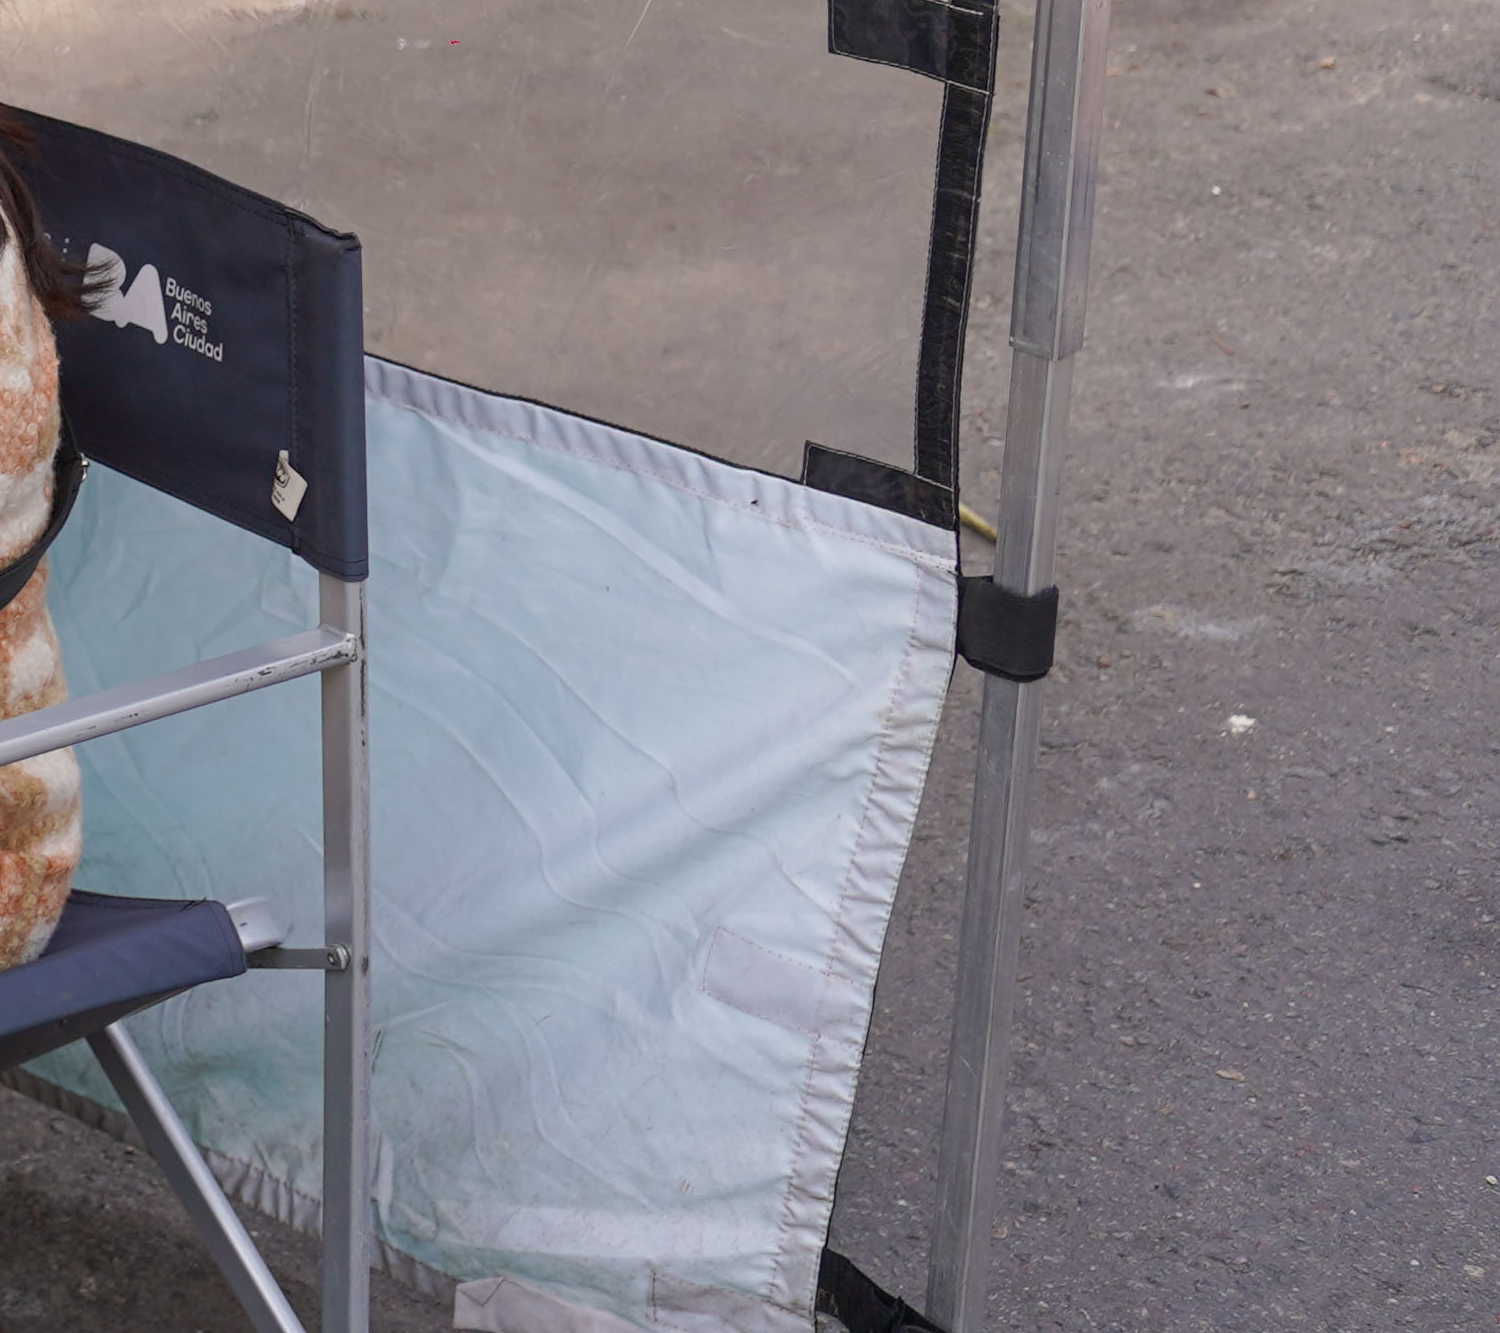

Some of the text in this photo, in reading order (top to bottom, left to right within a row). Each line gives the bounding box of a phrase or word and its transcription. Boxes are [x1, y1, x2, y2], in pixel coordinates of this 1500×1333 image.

[164, 277, 212, 317] Buenos
[170, 303, 208, 334] Aires
[172, 324, 224, 362] Ciudad
